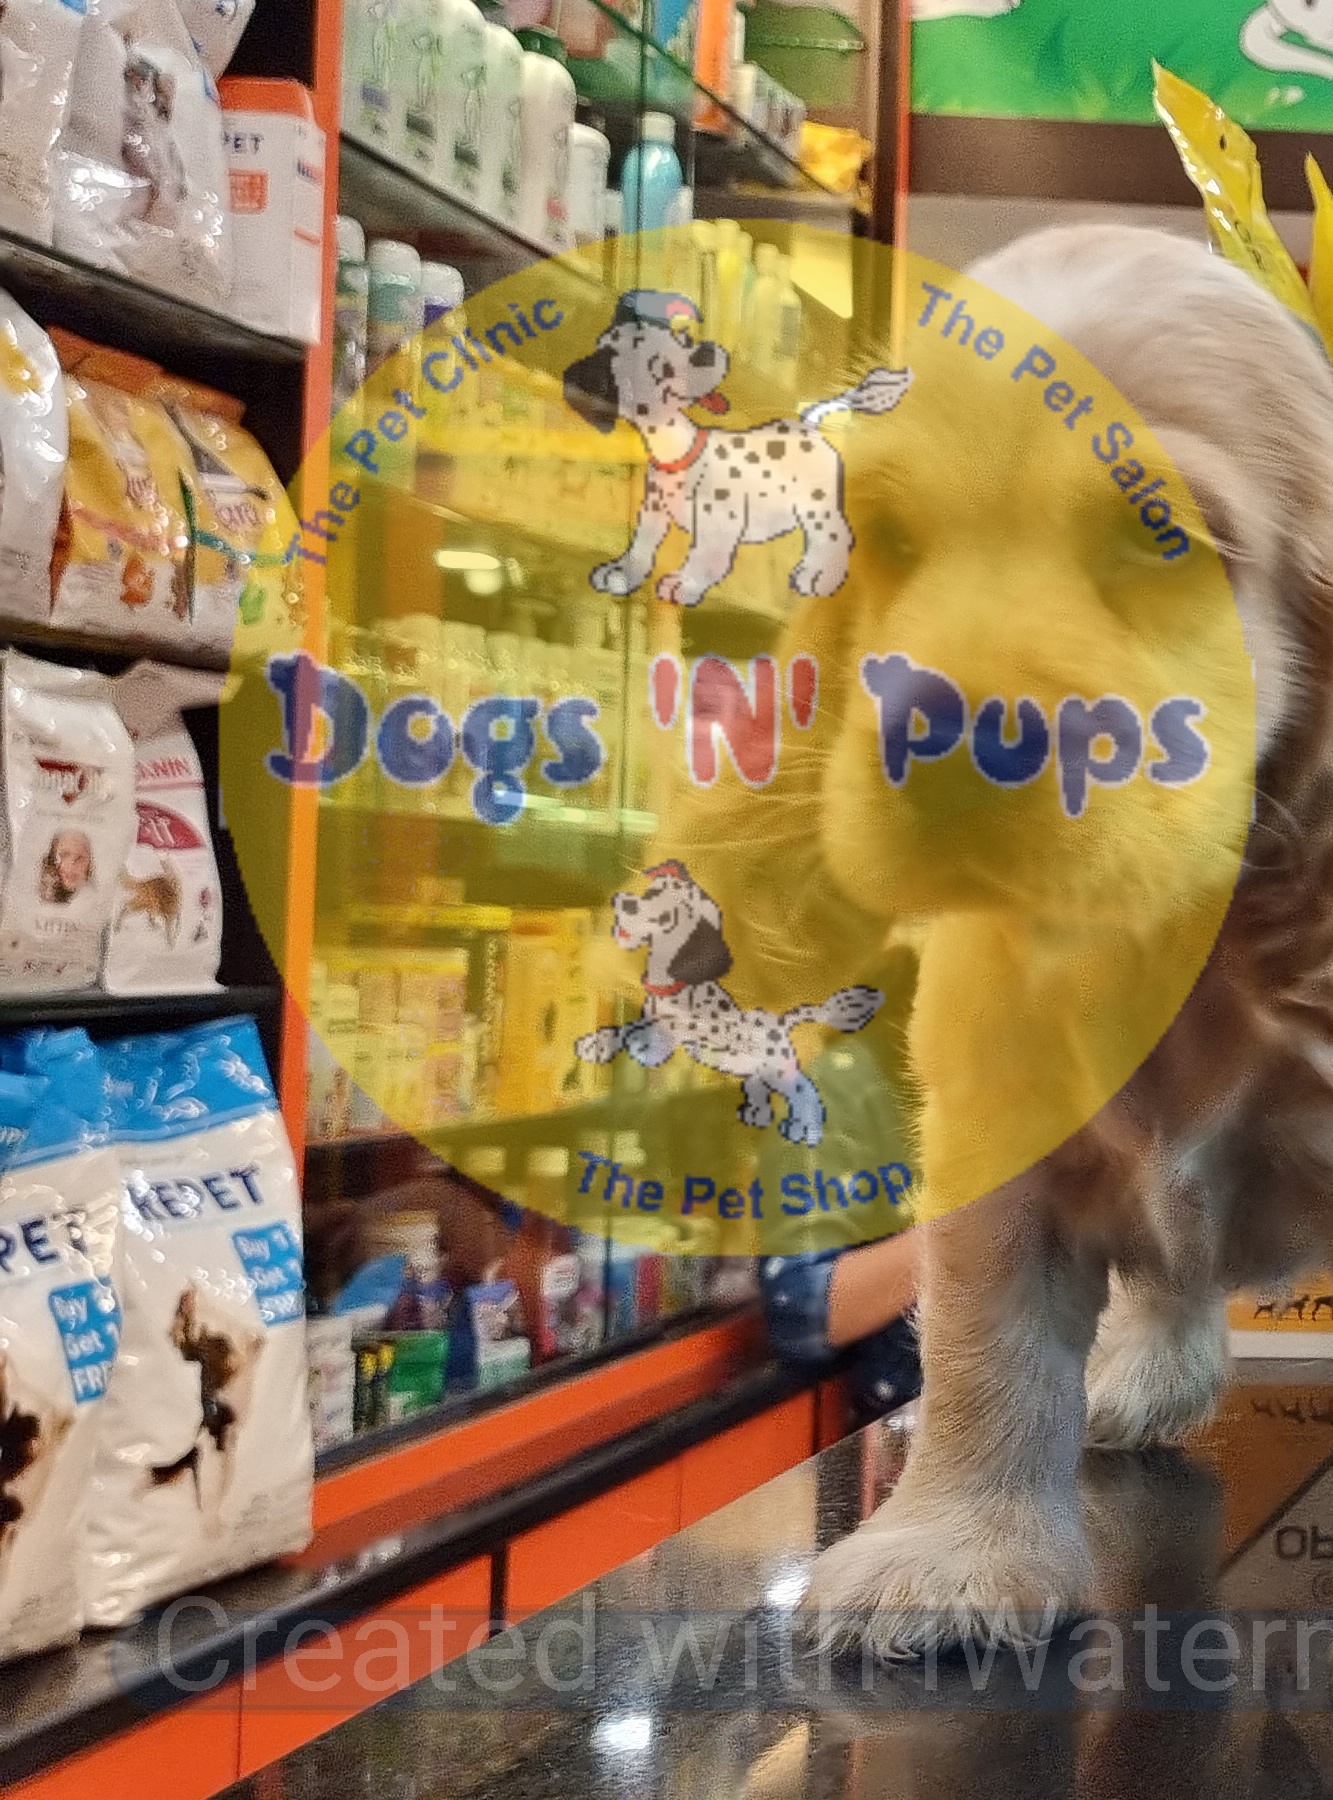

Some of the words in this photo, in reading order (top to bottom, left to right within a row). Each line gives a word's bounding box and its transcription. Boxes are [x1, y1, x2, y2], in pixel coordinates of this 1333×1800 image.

[54, 1296, 88, 1330] Buy
[67, 1332, 104, 1361] Get
[74, 1365, 110, 1397] FR
